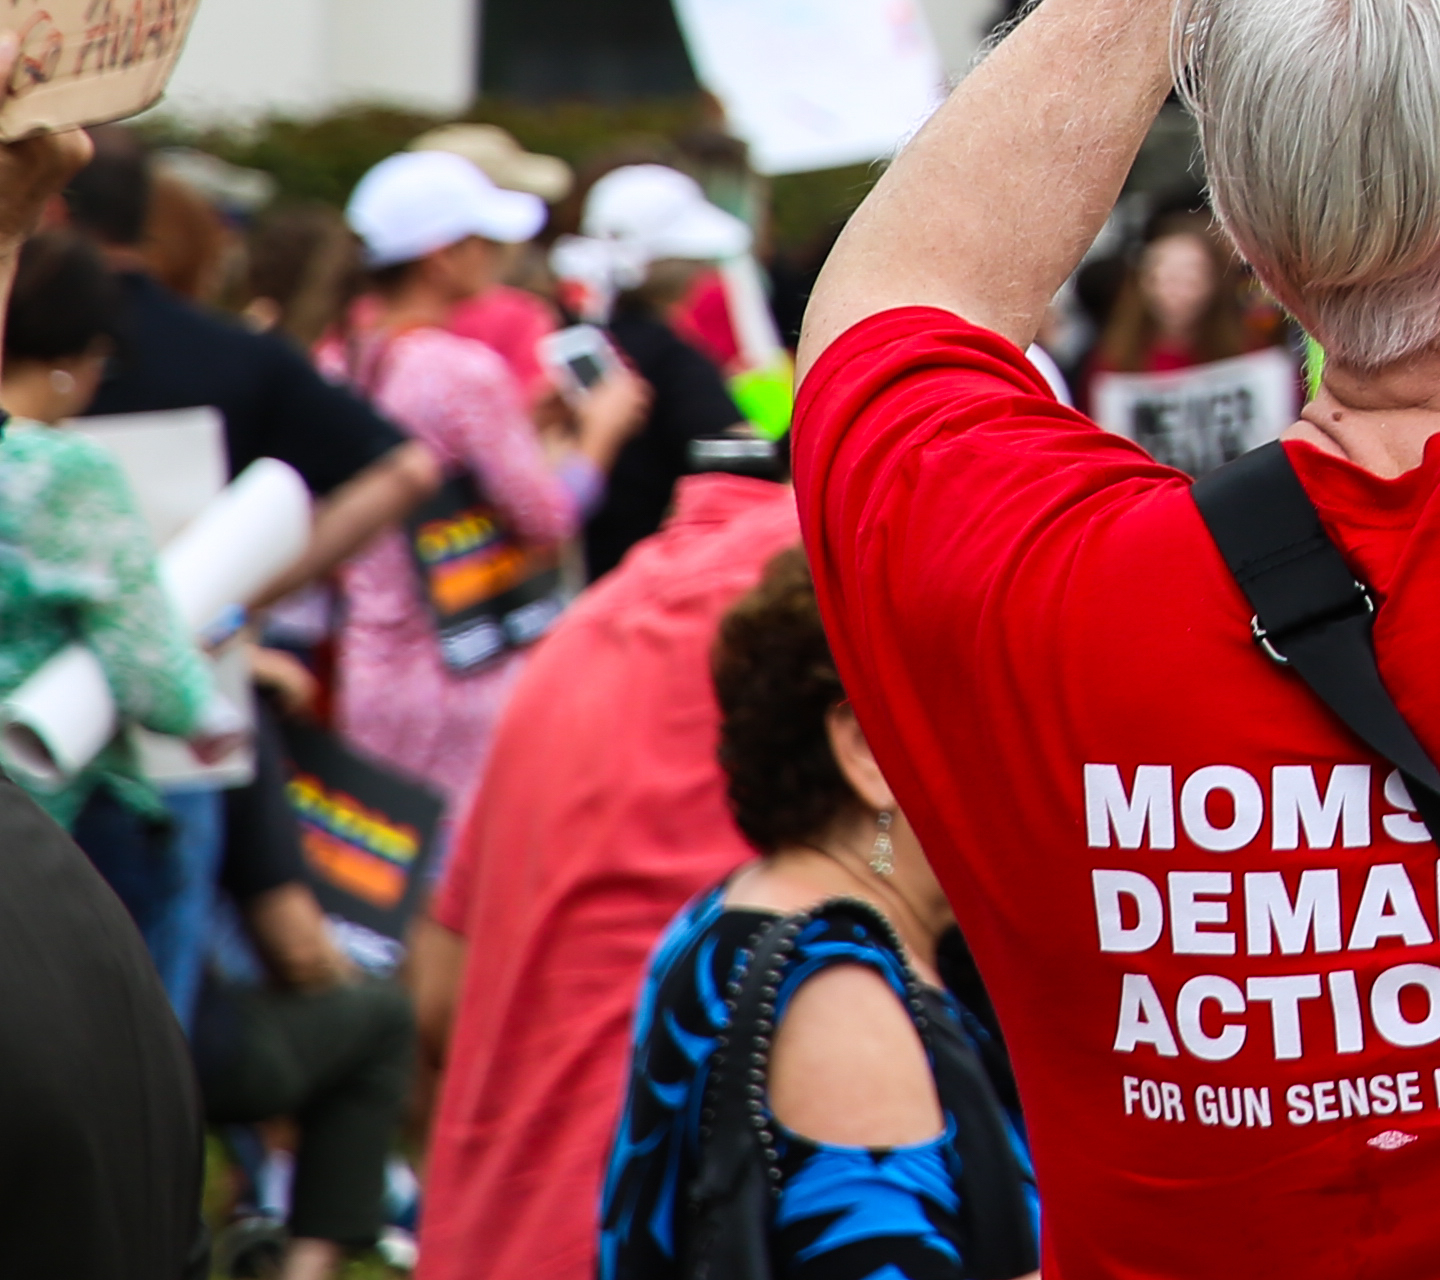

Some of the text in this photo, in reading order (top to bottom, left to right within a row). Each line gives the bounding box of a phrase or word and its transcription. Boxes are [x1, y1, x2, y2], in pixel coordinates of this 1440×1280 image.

[1123, 1076, 1185, 1123] FOR
[1195, 1085, 1272, 1128] GUN
[1286, 1071, 1423, 1125] SENSE
